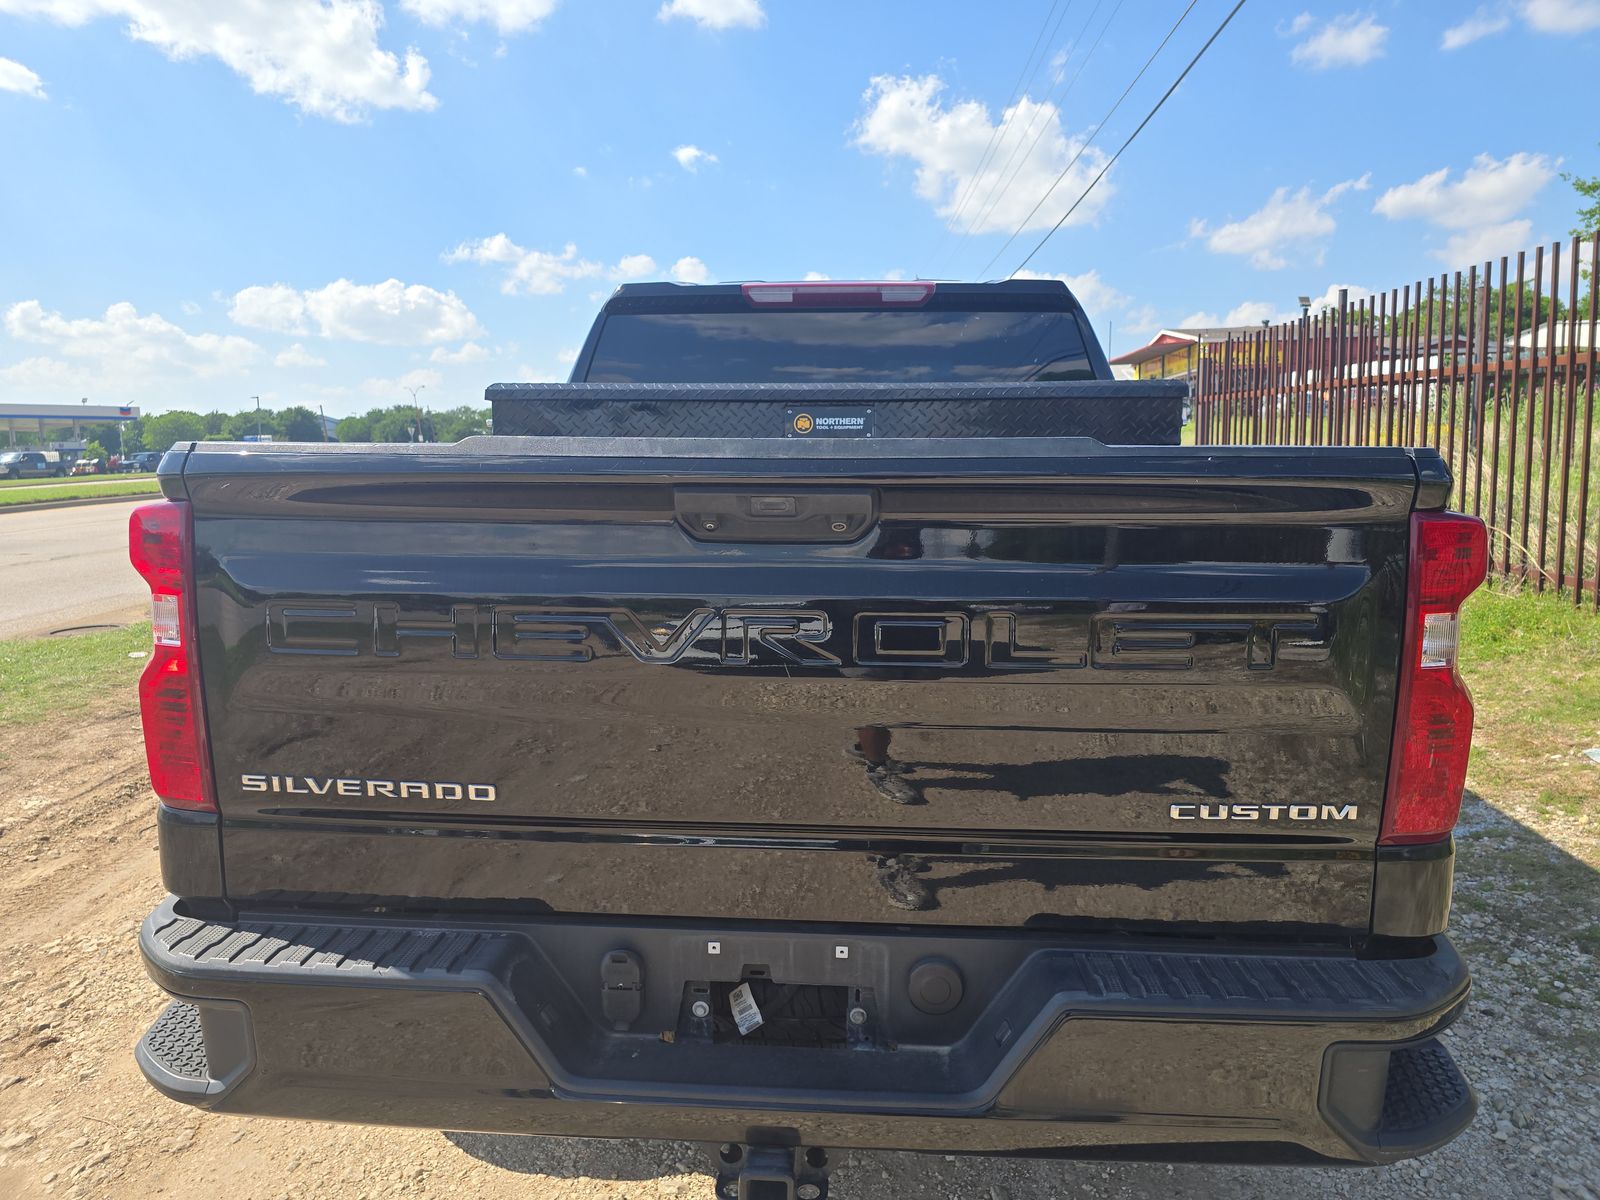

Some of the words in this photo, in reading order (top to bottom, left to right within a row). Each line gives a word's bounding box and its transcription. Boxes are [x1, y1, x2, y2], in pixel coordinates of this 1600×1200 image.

[815, 417, 864, 425] NORTHERN
[266, 600, 1319, 670] CHEVROLET
[241, 774, 496, 801] SILVERADO
[1169, 804, 1358, 820] CUSTOM
